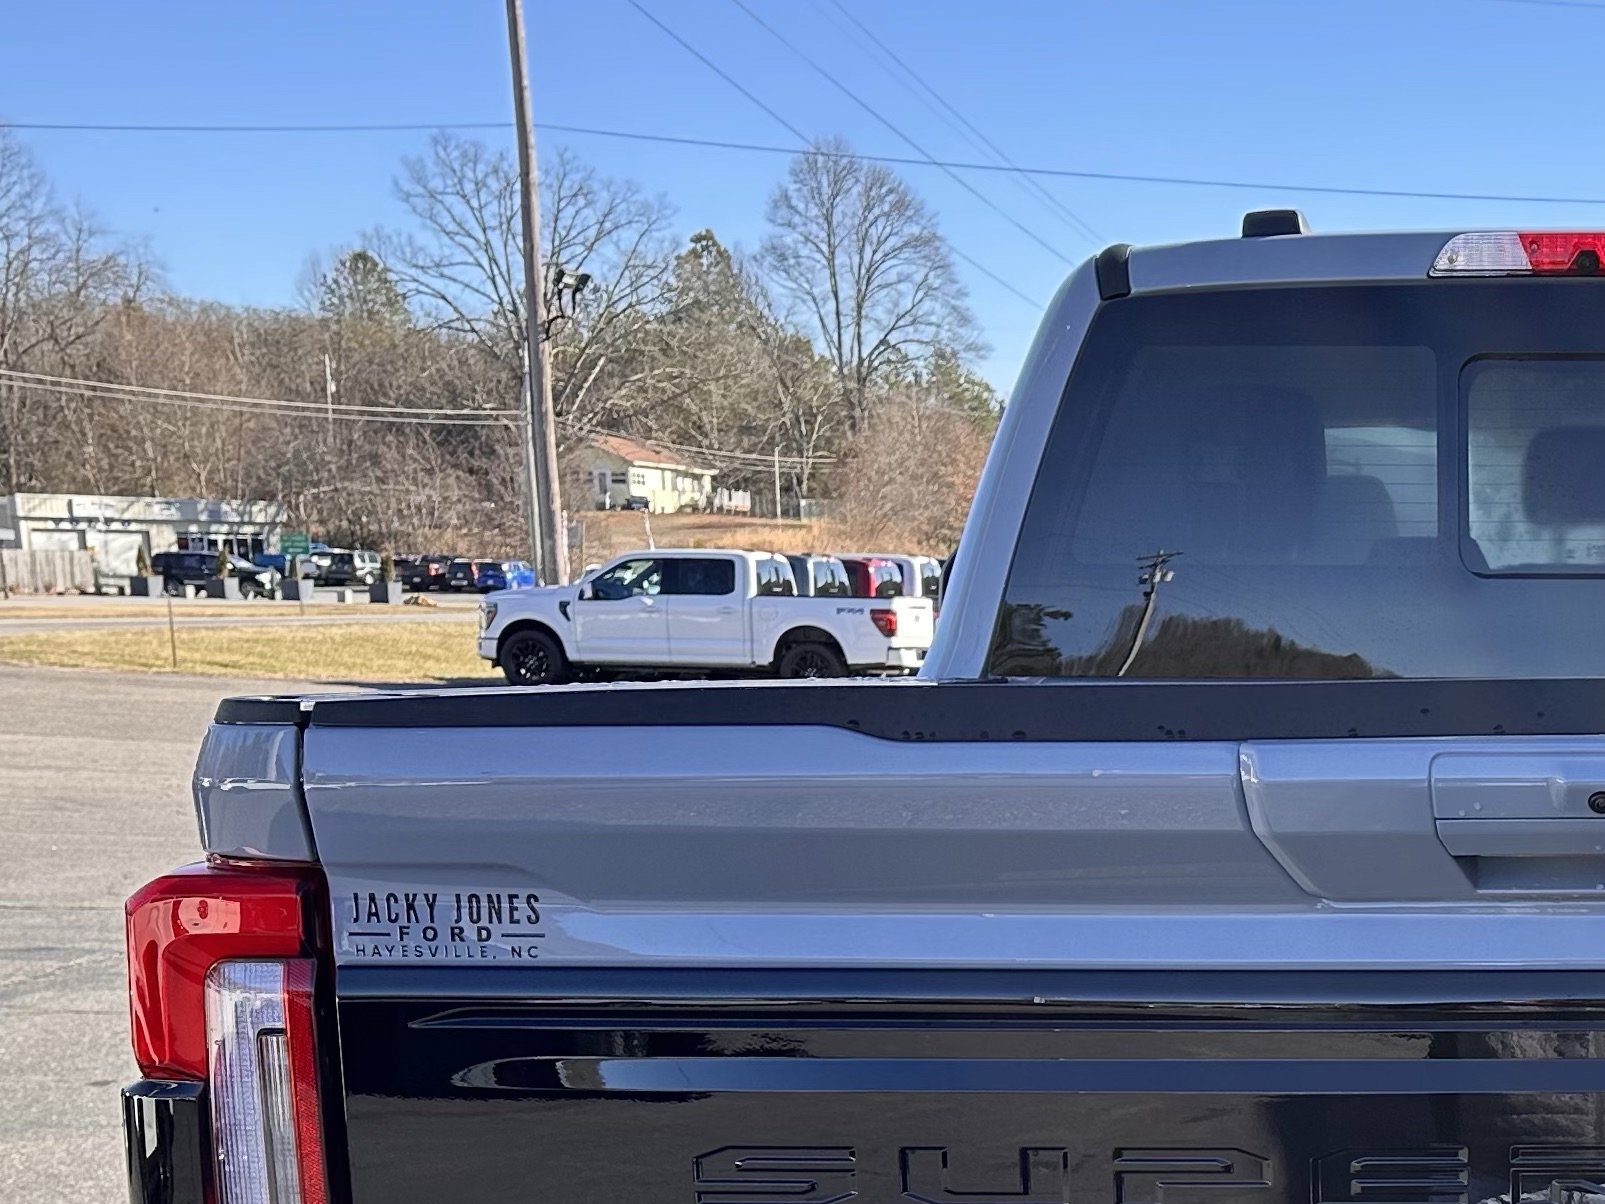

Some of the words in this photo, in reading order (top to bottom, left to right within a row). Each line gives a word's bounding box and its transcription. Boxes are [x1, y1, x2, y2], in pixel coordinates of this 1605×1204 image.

[352, 892, 438, 924] JACKY
[455, 893, 540, 925] JONES
[398, 926, 492, 942] FORD
[511, 946, 539, 959] NC
